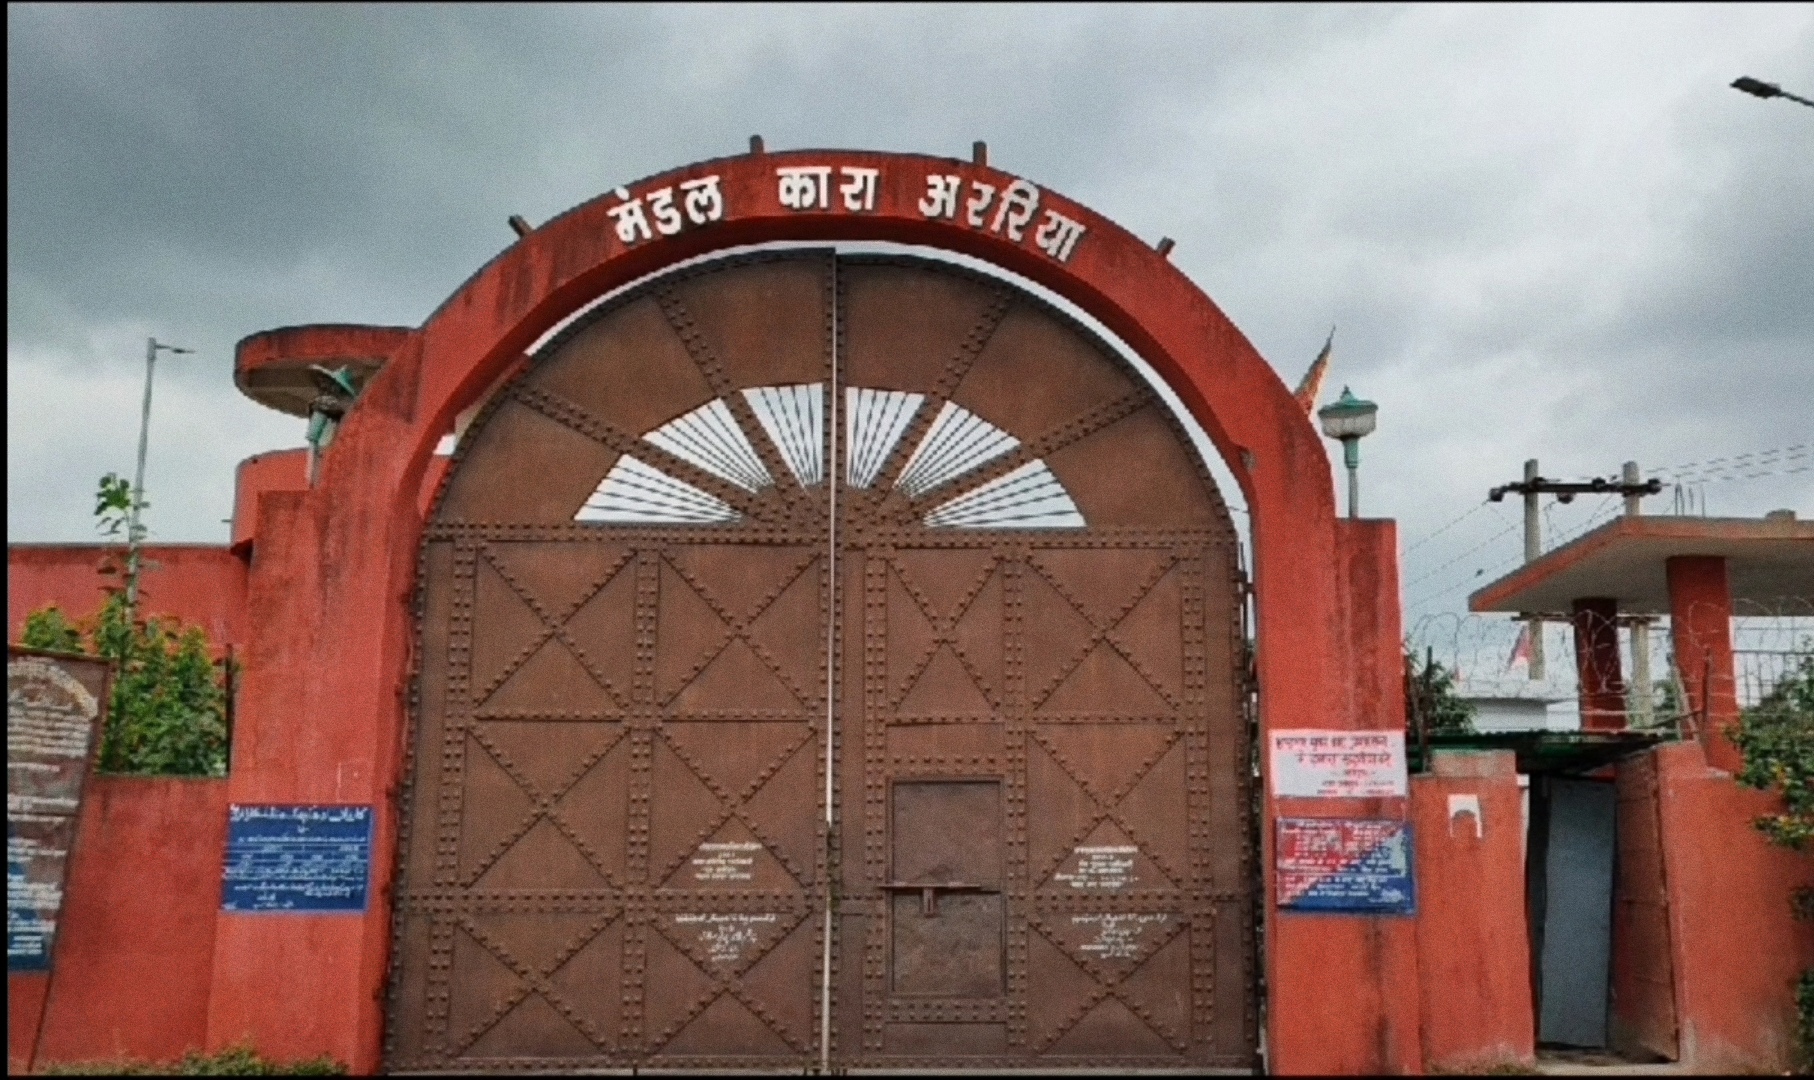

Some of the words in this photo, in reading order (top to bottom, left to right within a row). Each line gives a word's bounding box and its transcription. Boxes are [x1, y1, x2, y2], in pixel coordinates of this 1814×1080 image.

[607, 175, 722, 243] मंडल
[777, 165, 880, 212] कारा
[917, 173, 1087, 263] अररिया
